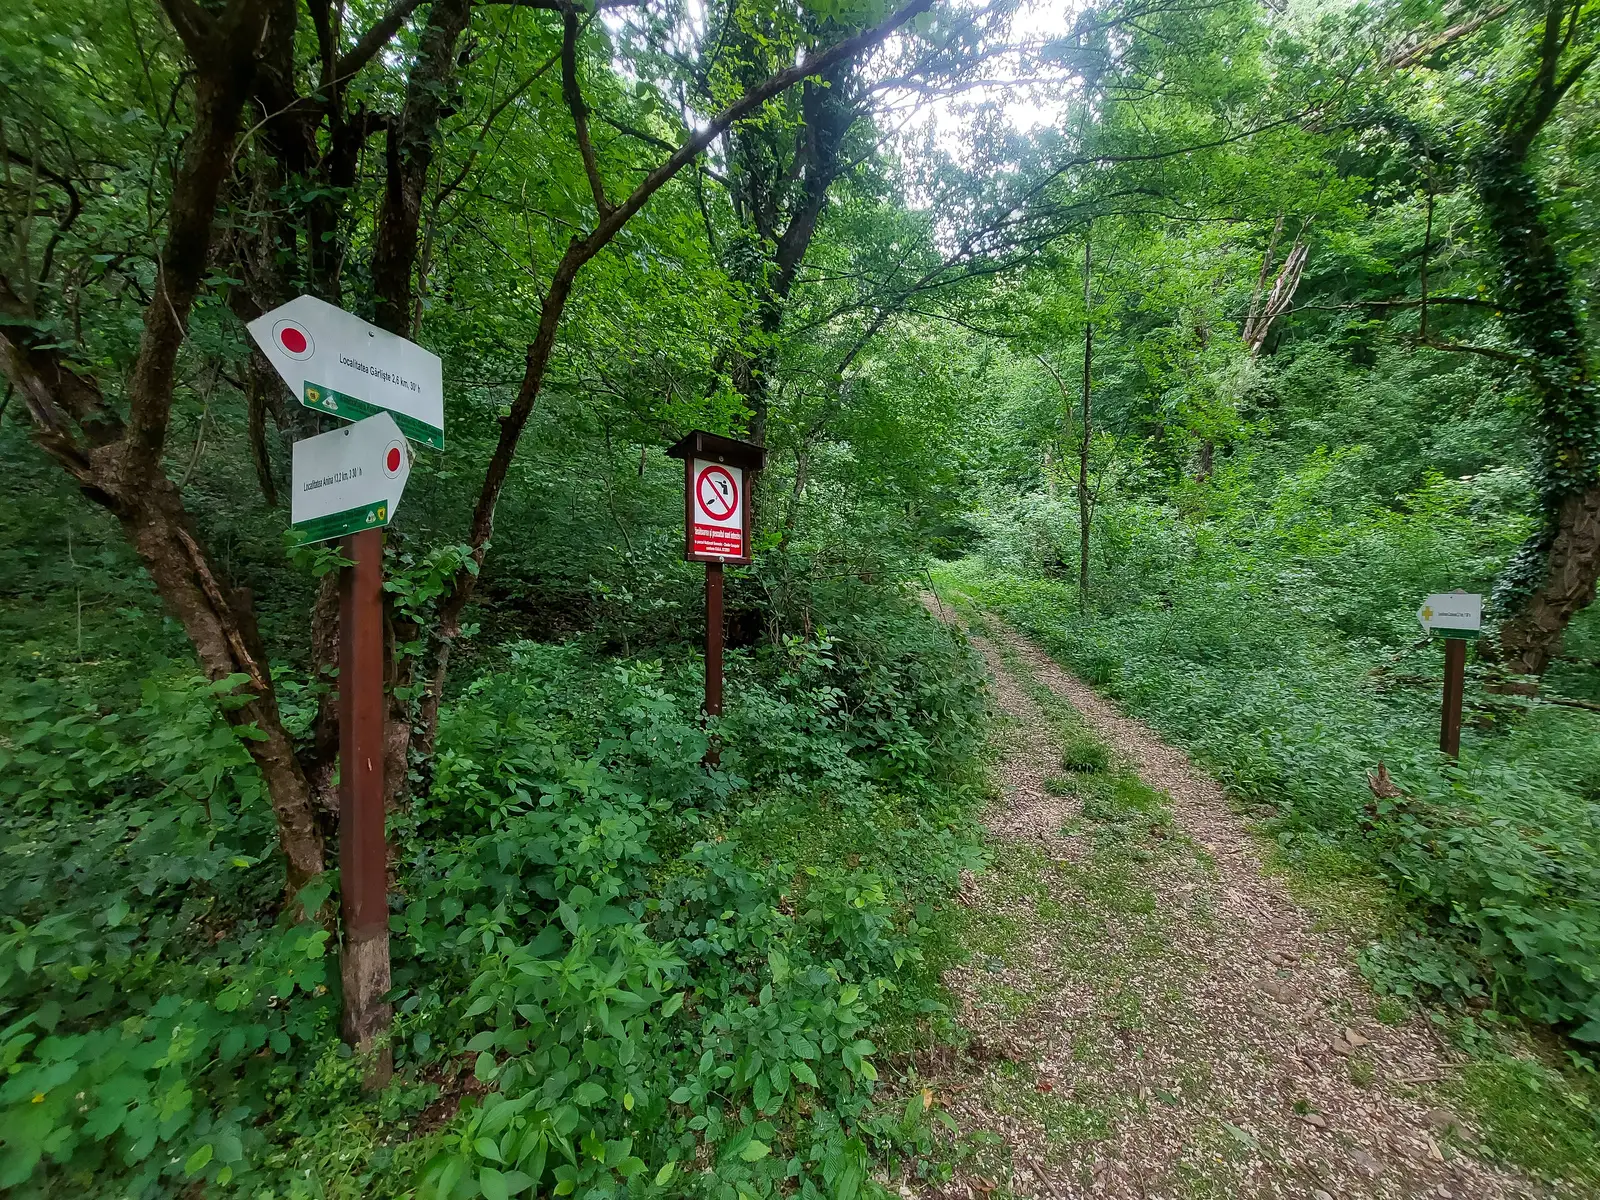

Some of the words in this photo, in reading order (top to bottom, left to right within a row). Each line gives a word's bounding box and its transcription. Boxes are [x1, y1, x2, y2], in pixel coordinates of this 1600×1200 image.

[339, 353, 369, 374] Localitatea
[391, 374, 400, 385] 2,6
[400, 377, 409, 390] km,
[303, 480, 322, 491] Localitatea
[322, 476, 333, 486] Anina
